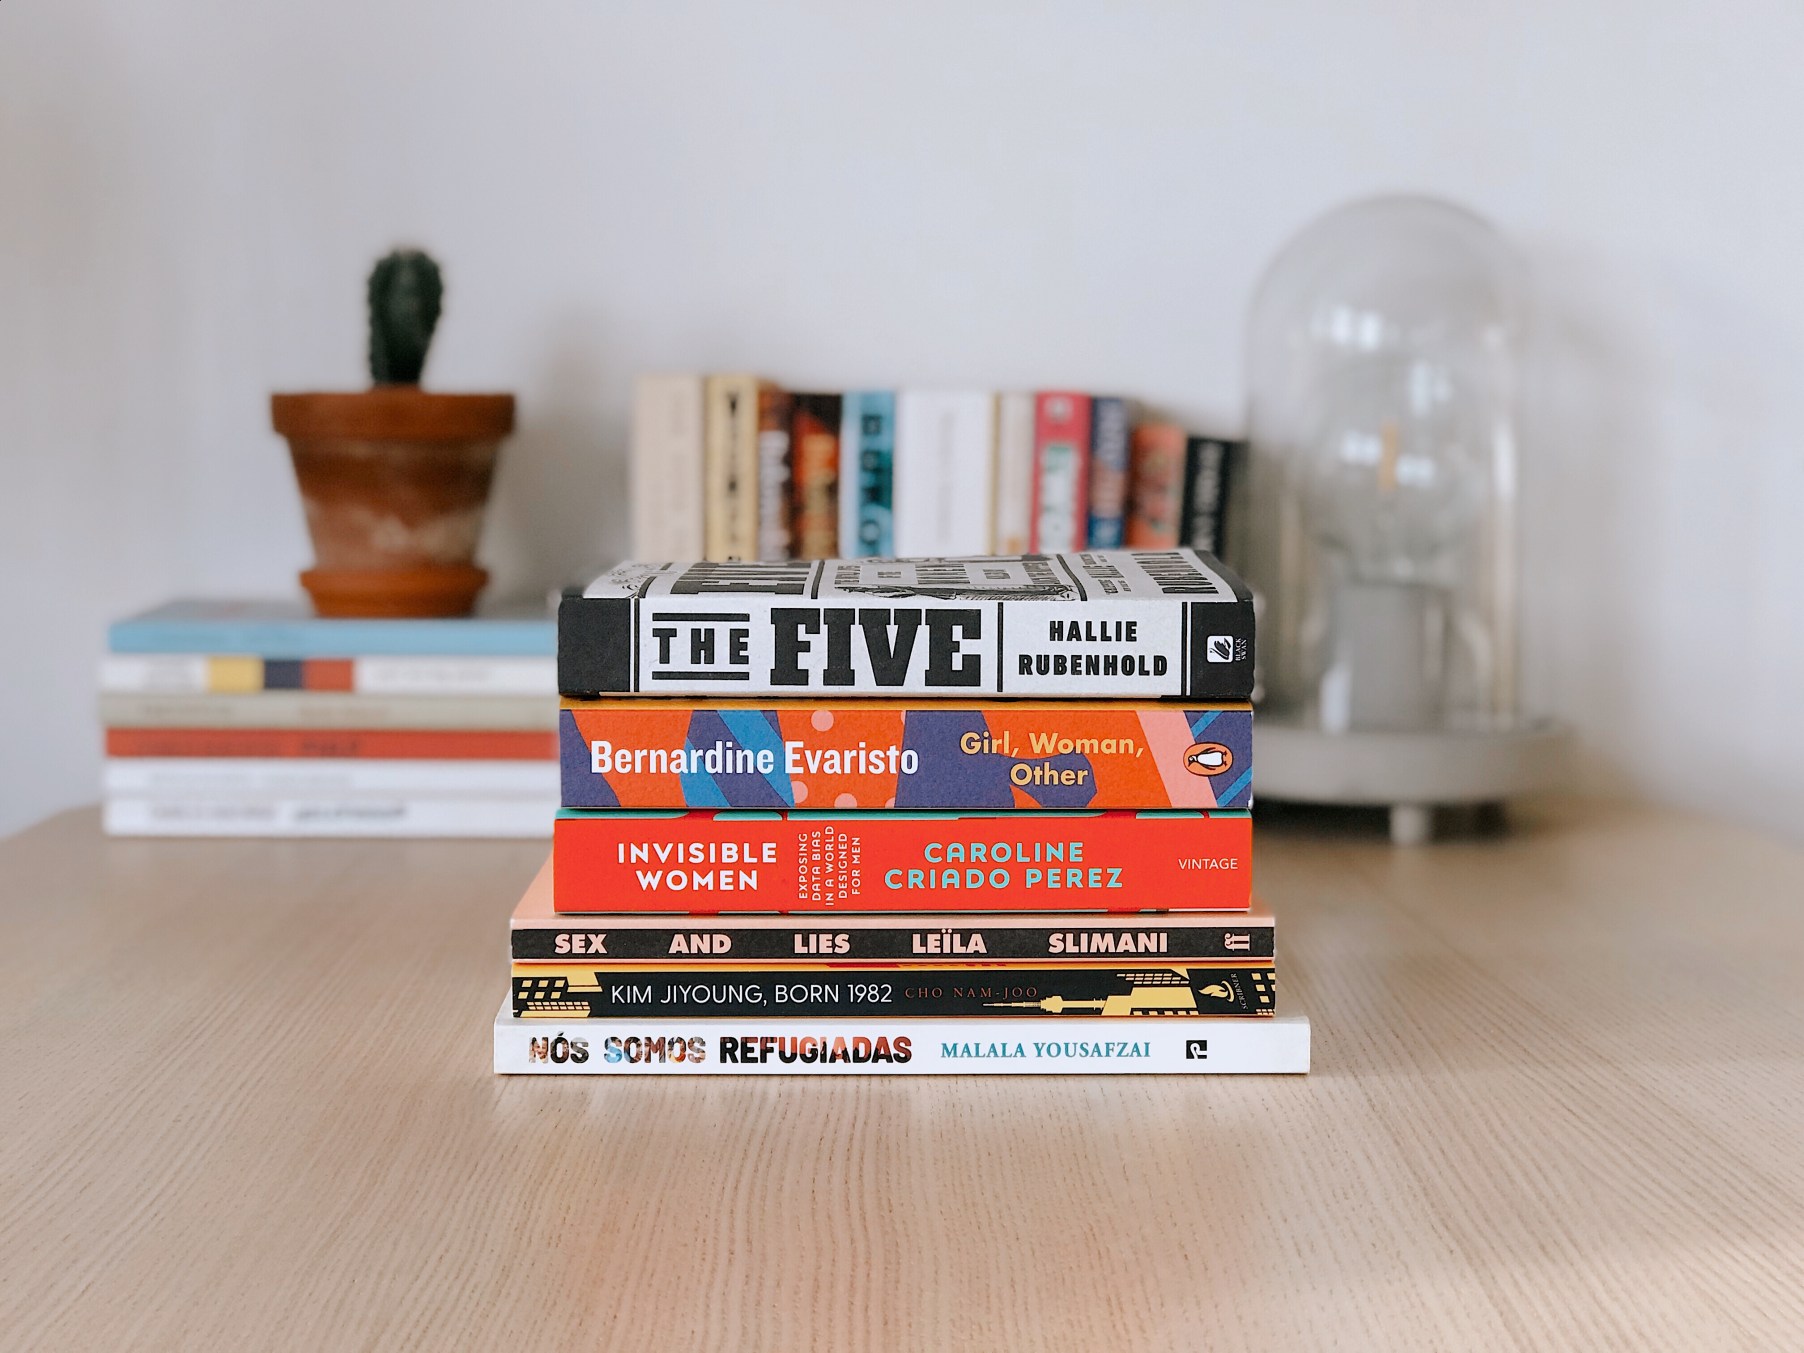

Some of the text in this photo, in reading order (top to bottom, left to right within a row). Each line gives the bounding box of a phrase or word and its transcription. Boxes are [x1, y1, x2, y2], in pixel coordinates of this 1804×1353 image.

[1050, 620, 1137, 642] HALLIE
[652, 608, 982, 687] THE FIVE
[1019, 653, 1167, 676] RUBENHOLD
[961, 732, 1145, 758] Girl, Woman,
[592, 741, 918, 774] Bernardine Evaristo
[1011, 762, 1088, 786] Other
[617, 842, 776, 864] INVISIBLE
[924, 841, 1084, 863] CAROLINE
[798, 834, 807, 899] EXPOSING
[811, 831, 821, 900] DATA BIAS
[824, 826, 835, 906] IN A WORLD
[837, 834, 848, 899] DESIGNED
[851, 838, 860, 894] FOR MEN
[1178, 858, 1237, 870] VINTAGE
[635, 869, 758, 891] WOMEN
[884, 867, 1122, 890] CRIADO PEREZ
[555, 934, 849, 953] SEX AND LIES
[913, 929, 1167, 953] LEÏLA SLIMANI
[613, 985, 891, 1006] KIM JIYOUNG, BORN 1982
[904, 987, 1038, 1000] CHO NAM-JOO
[529, 1031, 912, 1064] NÓS SOMOS REFUGIADAS
[941, 1042, 1150, 1058] MALALA YOUSAFZAI
